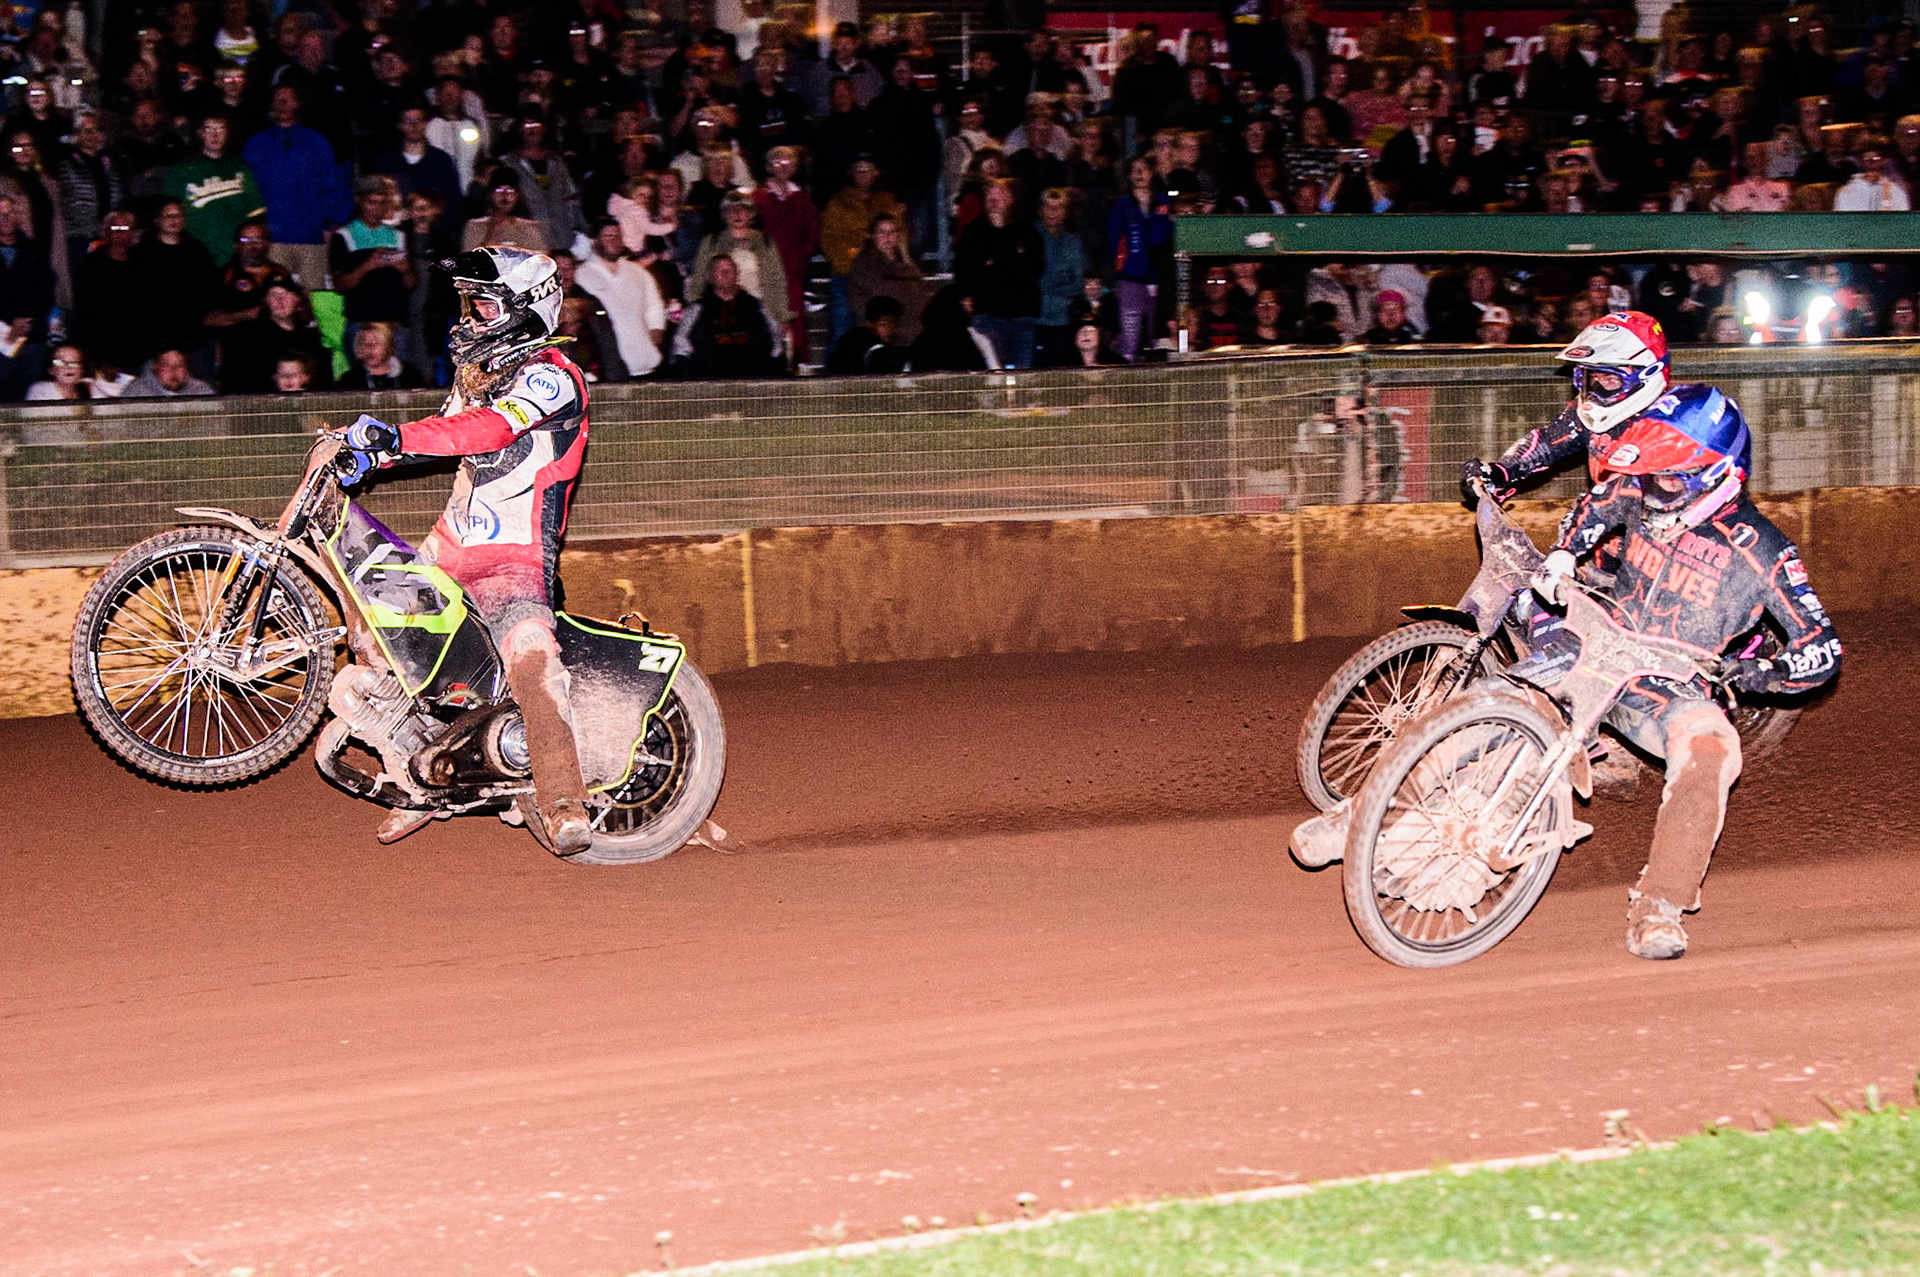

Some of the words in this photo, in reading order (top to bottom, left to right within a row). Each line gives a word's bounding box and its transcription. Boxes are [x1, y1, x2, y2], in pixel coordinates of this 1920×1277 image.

[532, 377, 556, 394] ATPI
[1672, 530, 1732, 569] RRYS
[1734, 526, 1754, 545] 1
[1625, 532, 1719, 608] WOVES
[639, 642, 681, 674] 27
[1739, 634, 1764, 660] 2
